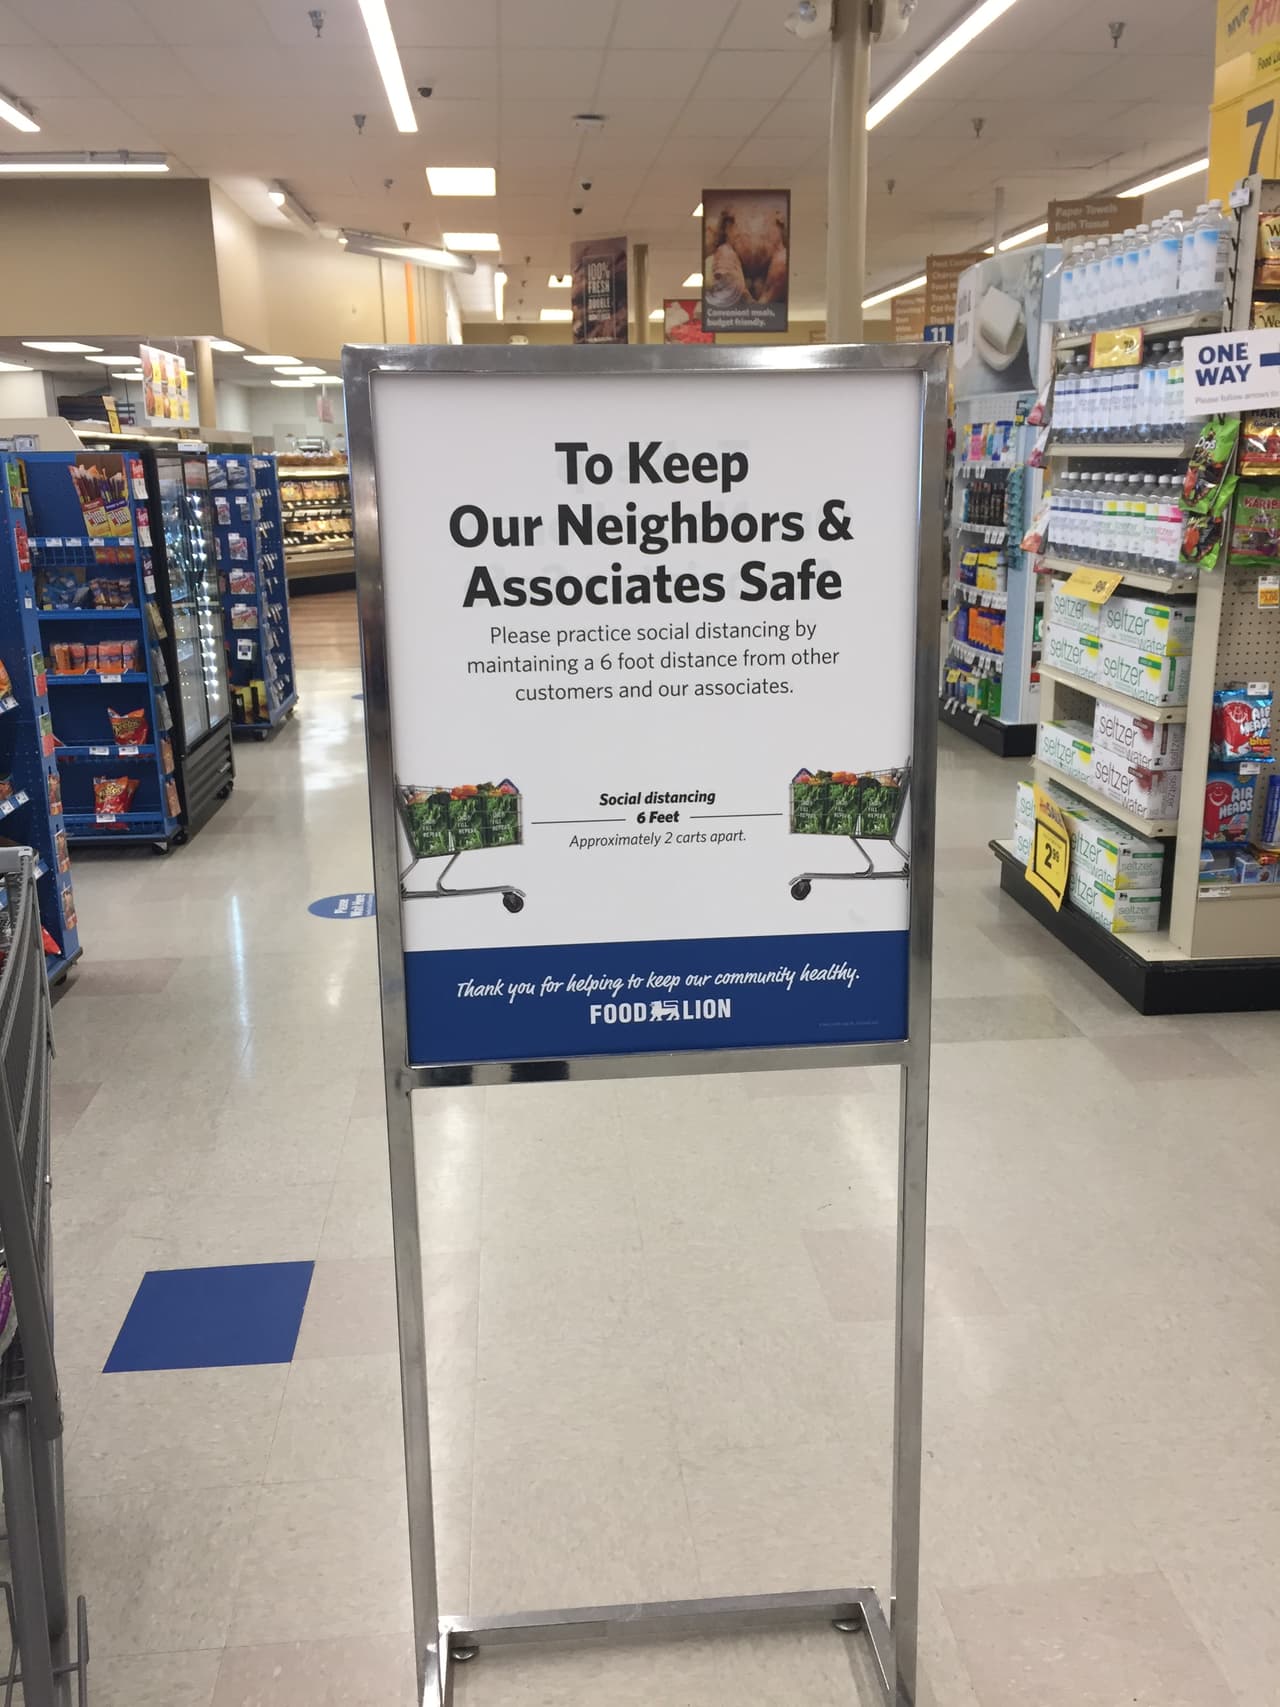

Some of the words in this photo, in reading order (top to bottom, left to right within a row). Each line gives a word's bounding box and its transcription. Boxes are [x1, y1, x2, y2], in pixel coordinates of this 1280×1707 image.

[1246, 99, 1274, 176] 7
[930, 327, 947, 341] 11
[1199, 343, 1248, 365] ONE
[1195, 364, 1252, 387] WAY
[555, 442, 613, 485] To
[629, 442, 748, 493] Keep
[450, 505, 543, 548] Our
[558, 500, 804, 554] Neighbors
[818, 499, 854, 541] &
[463, 562, 725, 607] Associates
[740, 559, 841, 601] Safe
[491, 626, 550, 644] Please
[557, 625, 631, 646] practice
[637, 623, 688, 640] social
[696, 621, 790, 641] distancing
[796, 619, 816, 640] by
[1106, 608, 1149, 636] seltzer
[468, 655, 578, 675] maintaining
[584, 658, 593, 670] a
[601, 653, 612, 670] 6
[618, 652, 654, 669] foot
[661, 651, 737, 668] distance
[743, 649, 785, 666] from
[792, 648, 839, 665] other
[1050, 637, 1085, 666] seltzer
[1103, 656, 1144, 687] seltzer
[516, 684, 613, 701] customers
[619, 680, 652, 698] and
[659, 684, 688, 697] our
[695, 678, 793, 696] associates.
[1100, 714, 1138, 748] seltzer
[1043, 736, 1077, 766] seltzer
[1095, 760, 1134, 796] seltzer
[599, 792, 641, 806] Social
[644, 790, 716, 805] distancing
[1231, 786, 1253, 801] AIR
[637, 812, 646, 824] 6
[649, 811, 680, 823] Feet
[1218, 800, 1252, 822] HEADS
[569, 832, 661, 850] Approximately
[664, 832, 673, 844] 2
[676, 832, 706, 843] carts
[710, 830, 746, 844] apart.
[458, 979, 504, 997] Thank
[508, 983, 535, 1003] you
[540, 976, 564, 996] for
[566, 974, 624, 997] helping
[628, 974, 644, 989] to
[646, 971, 680, 992] keep
[686, 975, 712, 986] our
[714, 966, 796, 990] community
[800, 962, 859, 985] healthy.
[590, 1003, 646, 1024] FOOD
[683, 999, 730, 1019] LION
